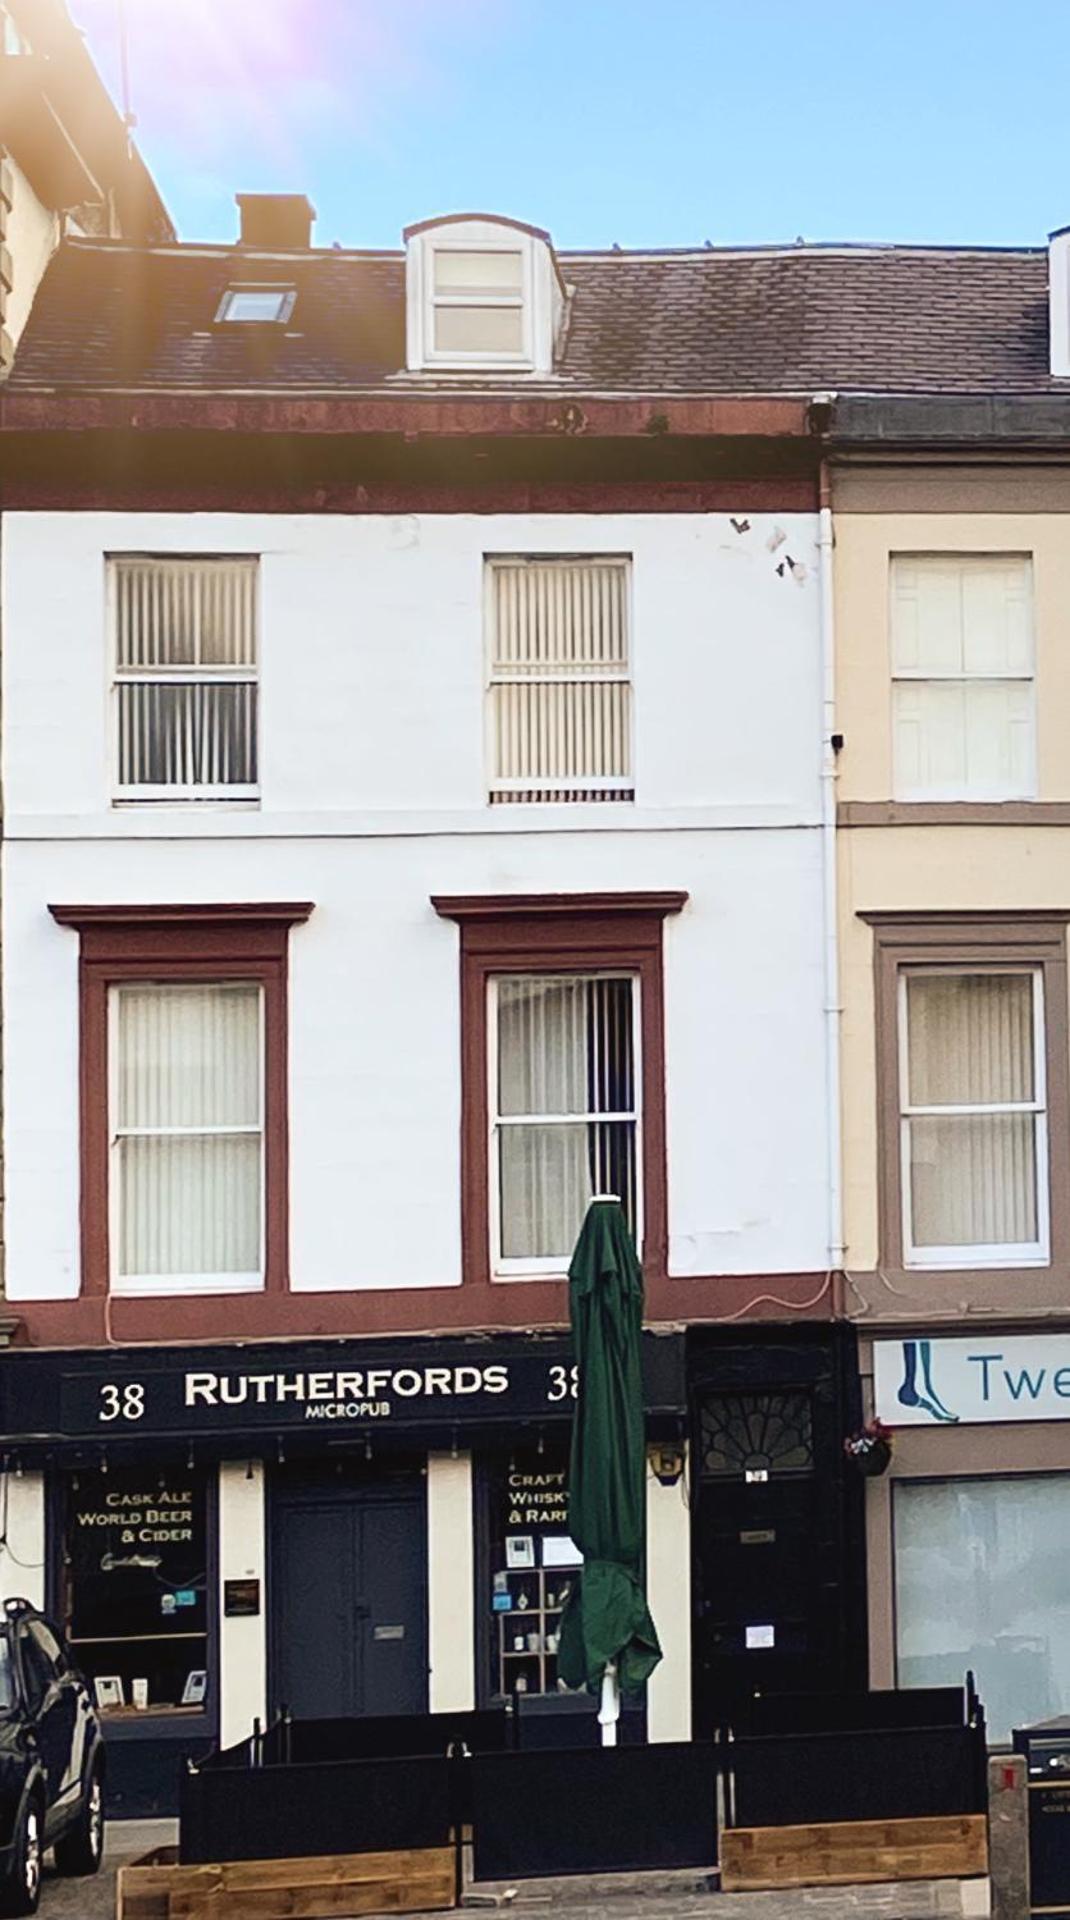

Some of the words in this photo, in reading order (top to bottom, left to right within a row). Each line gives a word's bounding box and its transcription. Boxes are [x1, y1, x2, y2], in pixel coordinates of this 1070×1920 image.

[184, 1366, 509, 1406] RUTHERFORDS
[99, 1384, 145, 1421] 38
[305, 1402, 391, 1418] MICROPUB
[508, 1473, 565, 1487] CRAFT
[106, 1493, 154, 1506] CASK
[158, 1491, 192, 1504] ALE
[508, 1491, 571, 1505] WHISK
[77, 1512, 142, 1526] WORLD
[146, 1509, 192, 1524] BEER
[508, 1509, 522, 1524] &
[121, 1529, 135, 1543] &
[139, 1528, 193, 1542] CIDER
